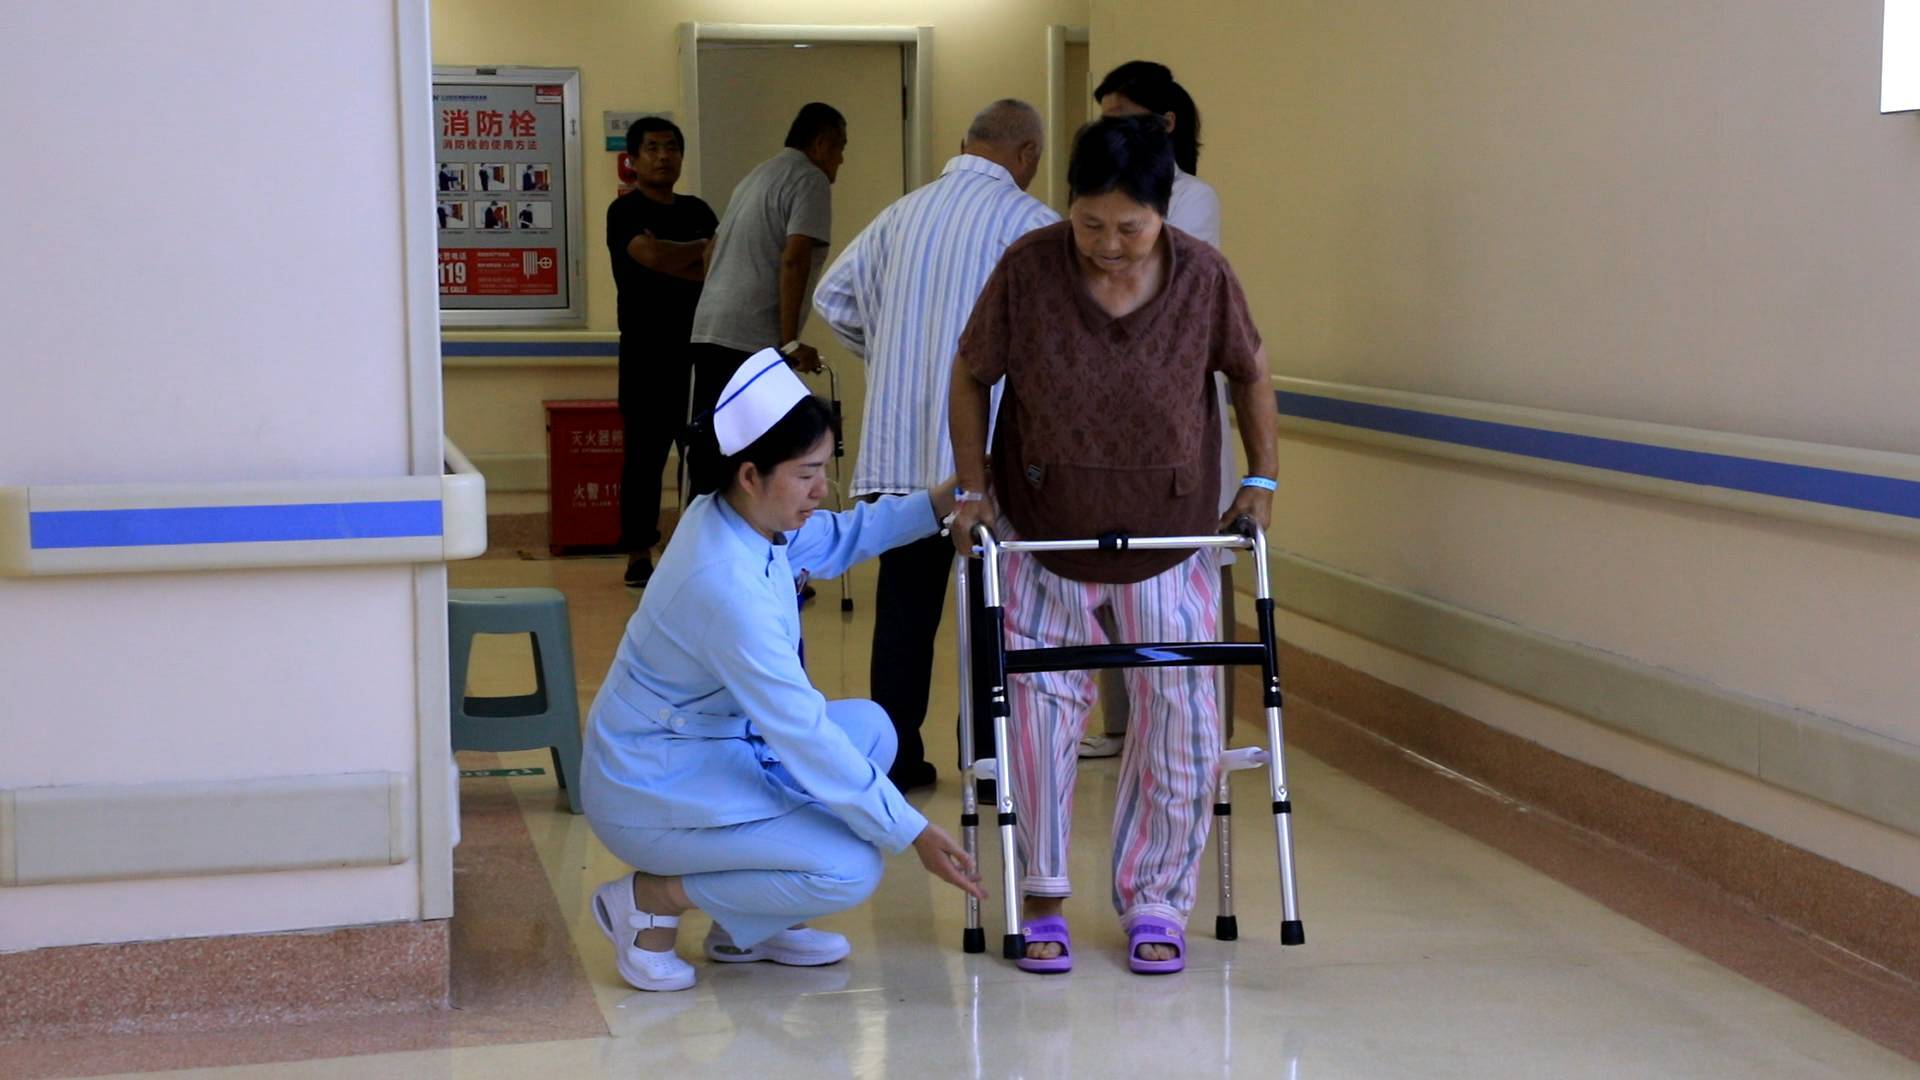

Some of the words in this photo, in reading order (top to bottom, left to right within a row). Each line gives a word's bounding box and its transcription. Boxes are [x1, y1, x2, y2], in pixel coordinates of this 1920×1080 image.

[442, 109, 537, 137] 消防栓
[443, 140, 538, 150] 消防栓的使用方法
[439, 251, 467, 261] 警电话
[439, 262, 467, 284] 119
[573, 481, 600, 500] 火警
